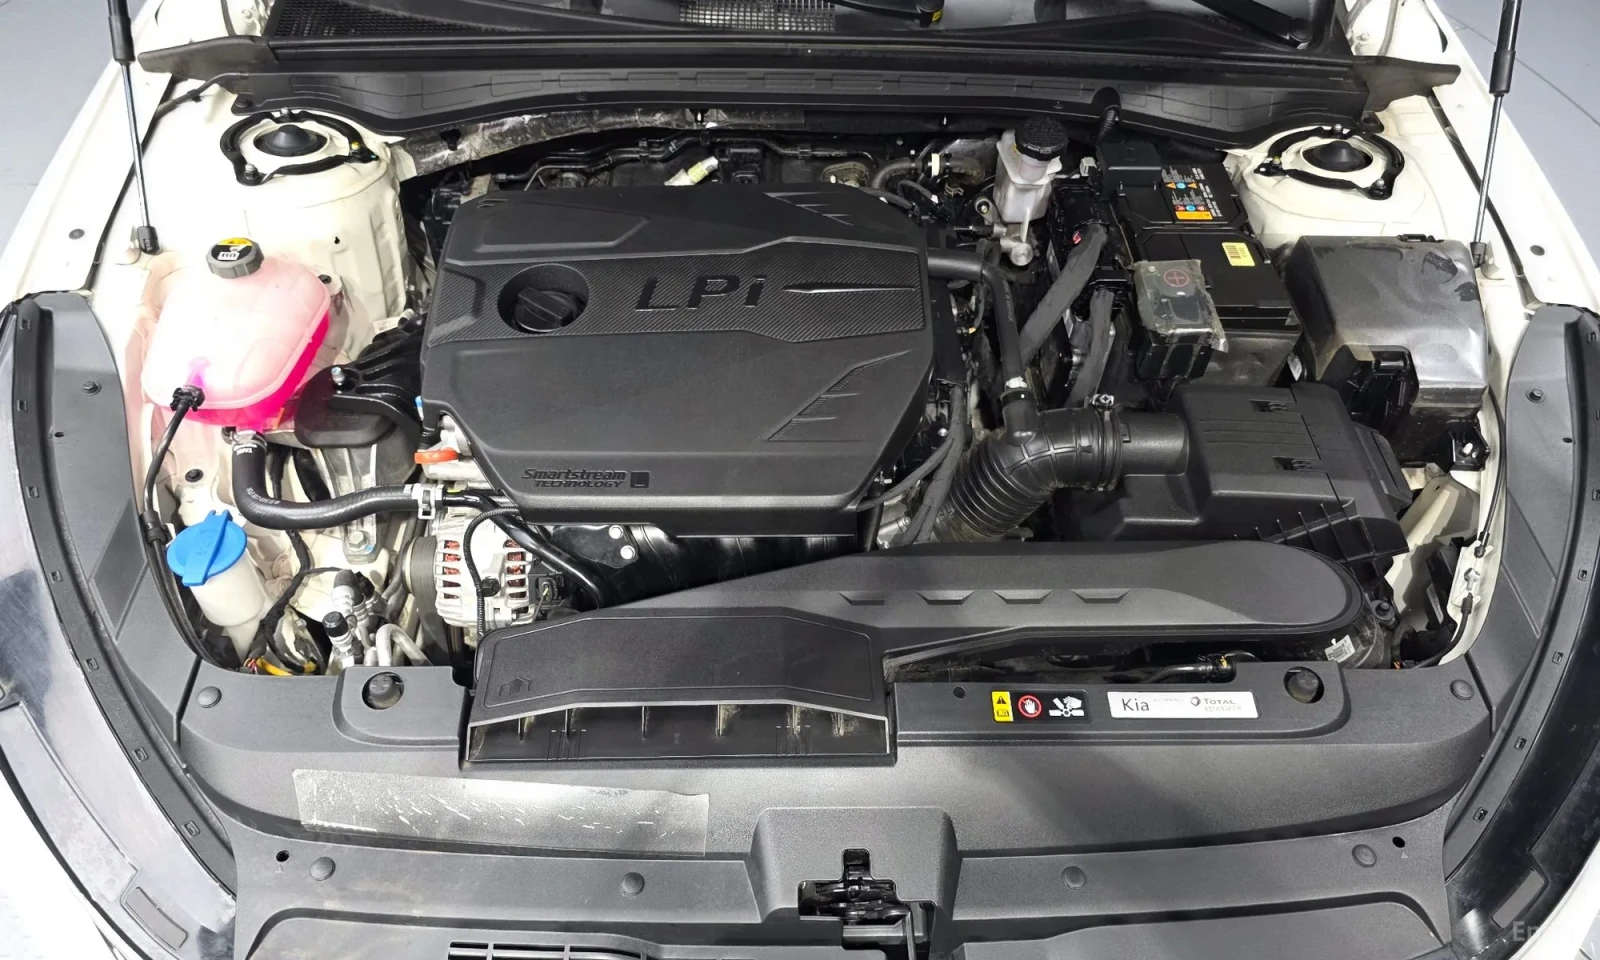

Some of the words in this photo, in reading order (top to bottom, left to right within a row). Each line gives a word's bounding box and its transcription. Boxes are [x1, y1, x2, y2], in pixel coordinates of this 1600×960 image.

[635, 275, 767, 311] LPi
[521, 468, 627, 480] Smartstream
[535, 480, 624, 488] TECHNOLOGY
[1121, 698, 1150, 711] Kia
